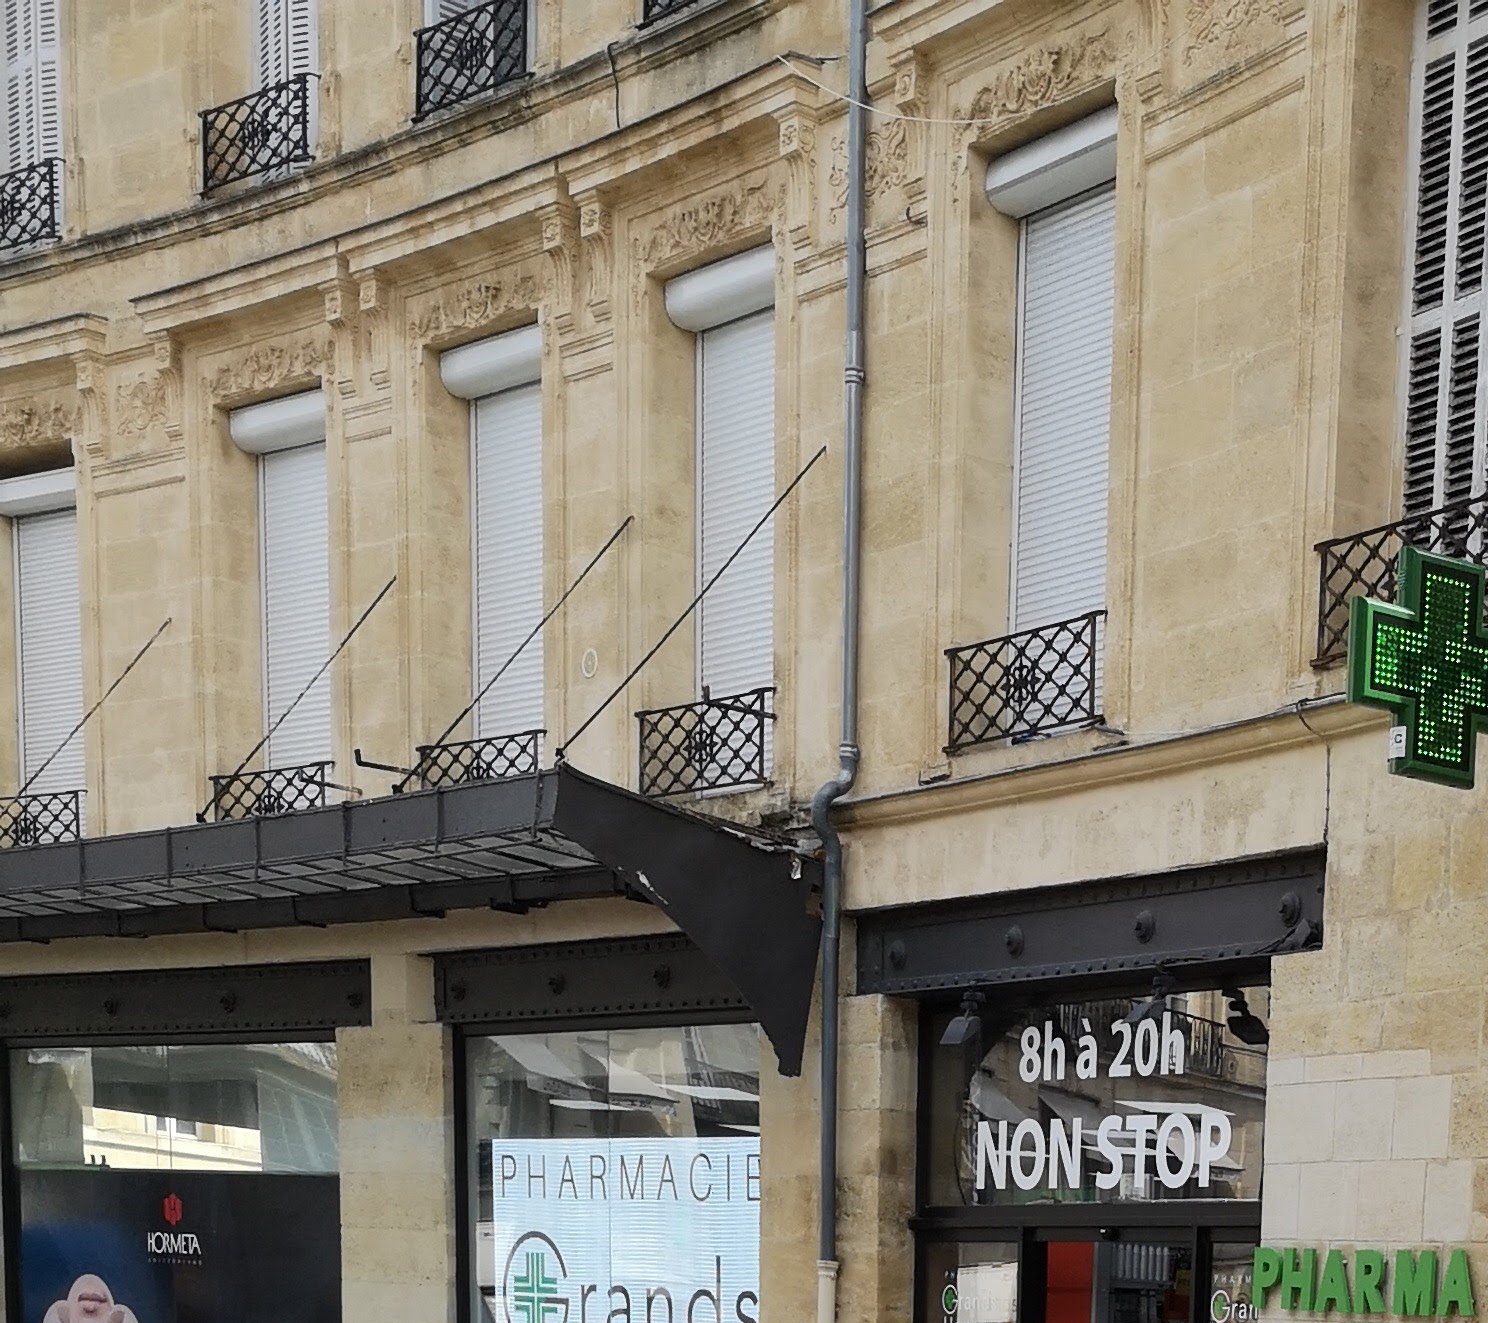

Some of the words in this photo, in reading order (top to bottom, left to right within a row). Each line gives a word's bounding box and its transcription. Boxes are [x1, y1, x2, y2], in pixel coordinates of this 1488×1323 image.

[1018, 1019, 1066, 1083] 8h
[1076, 1017, 1098, 1080] à
[1108, 1010, 1186, 1079] 20h
[501, 1152, 761, 1202] PHARMACIE
[976, 1116, 1083, 1191] NON
[1095, 1112, 1233, 1191] STOP
[147, 1231, 202, 1256] HORMETA
[1252, 1246, 1476, 1318] PHARMA
